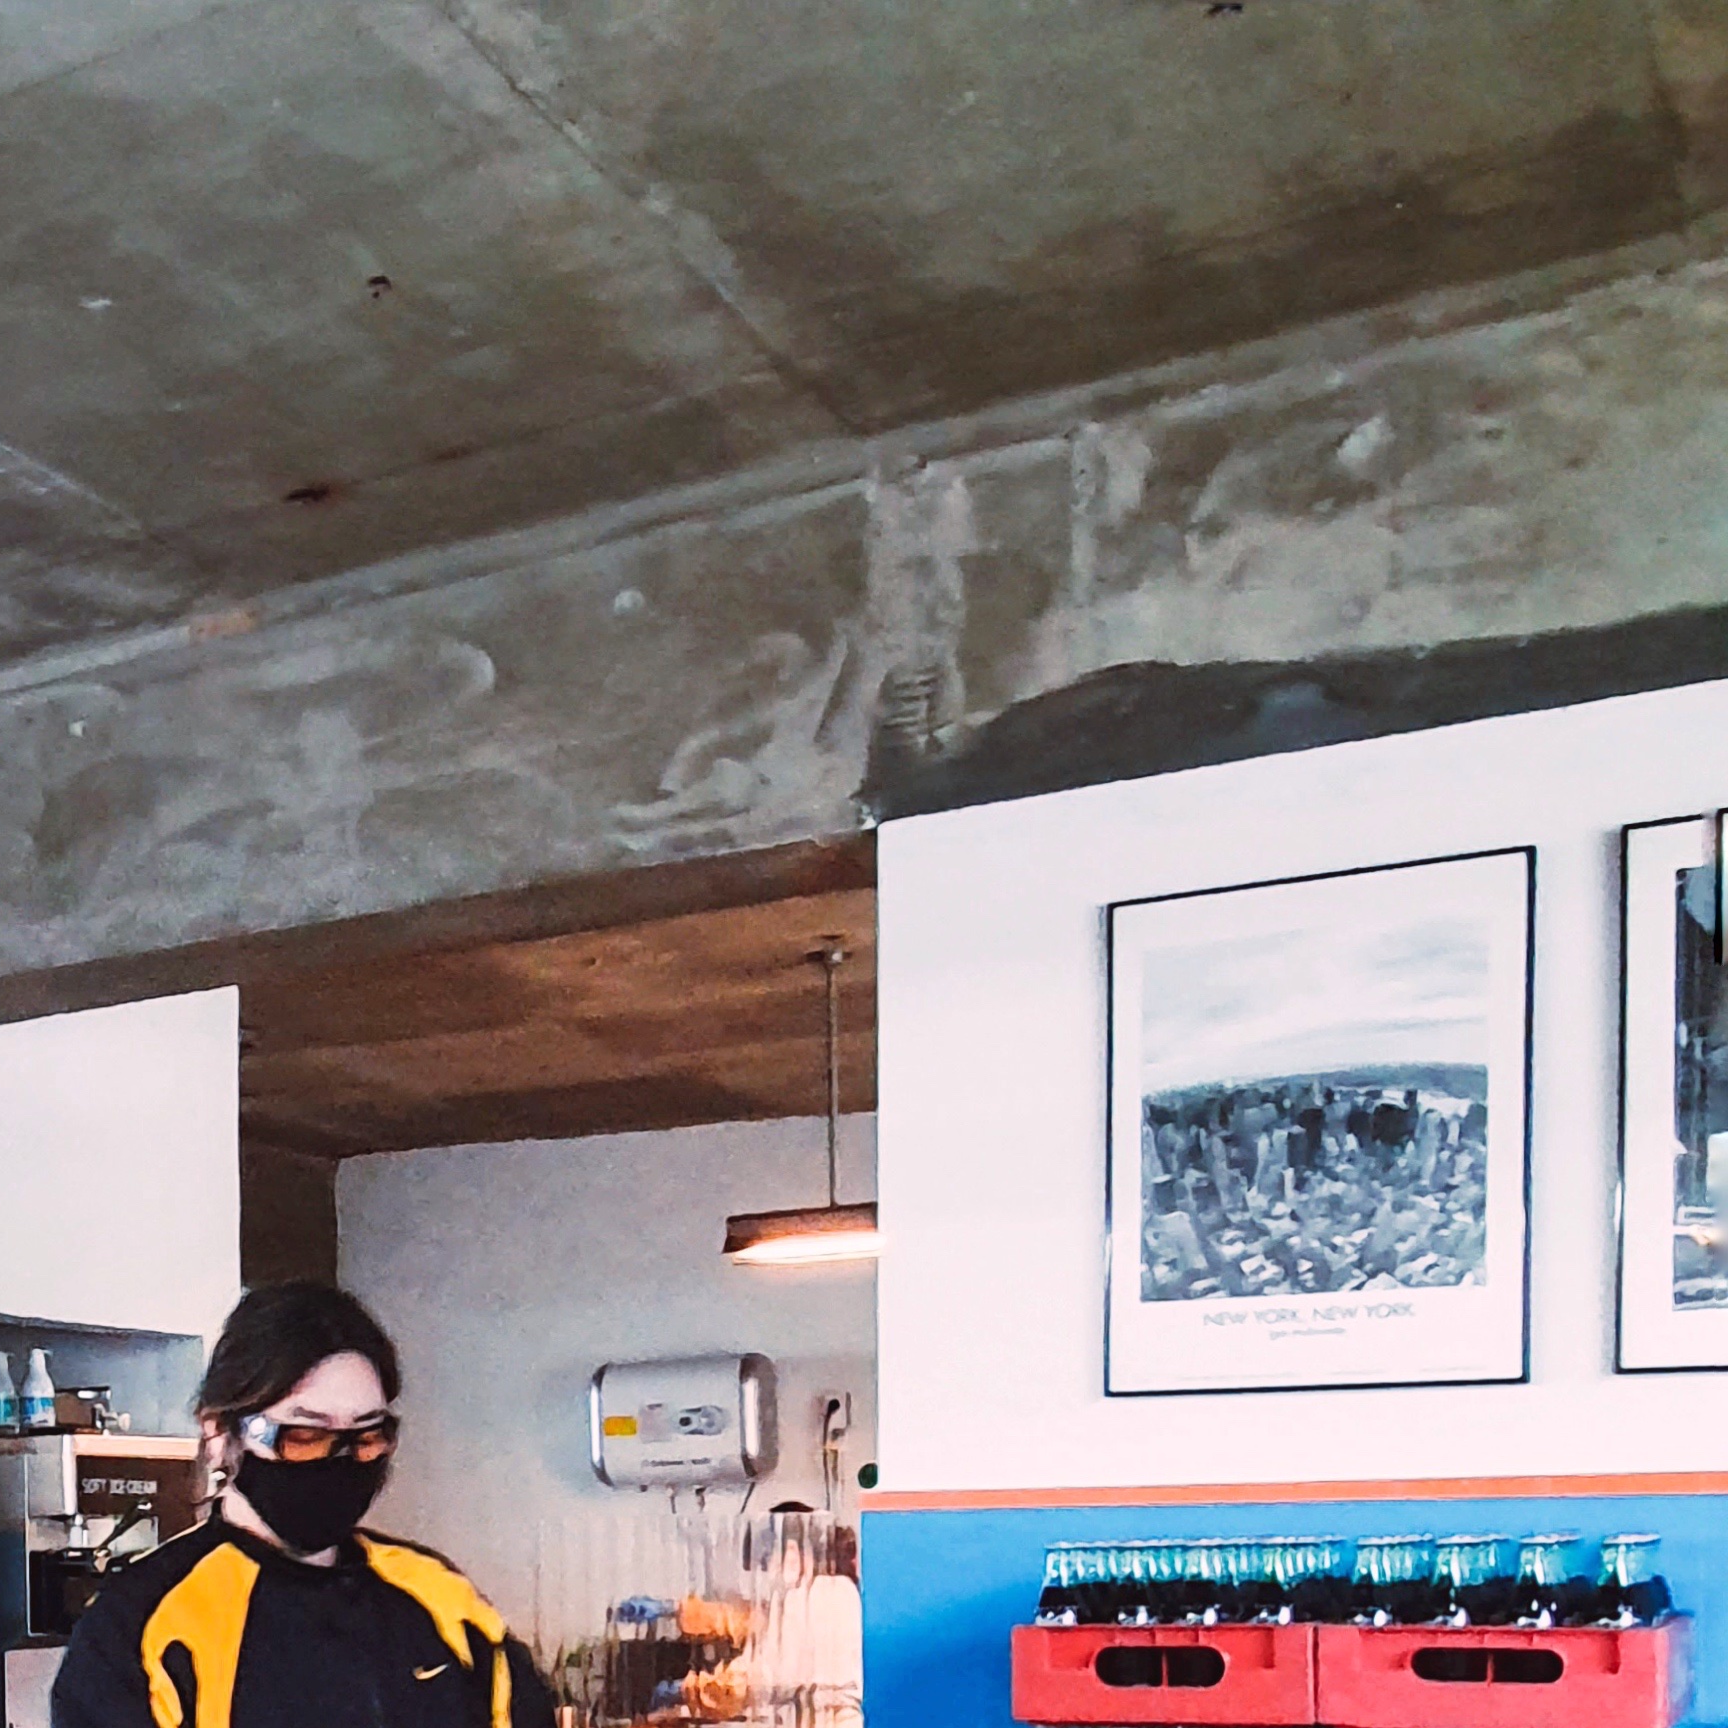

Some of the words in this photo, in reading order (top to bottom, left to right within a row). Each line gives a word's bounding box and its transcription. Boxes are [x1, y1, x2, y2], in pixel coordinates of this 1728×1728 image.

[1203, 1311, 1247, 1326] NEW
[1313, 1305, 1358, 1321] NEW
[82, 1477, 106, 1494] SOFT
